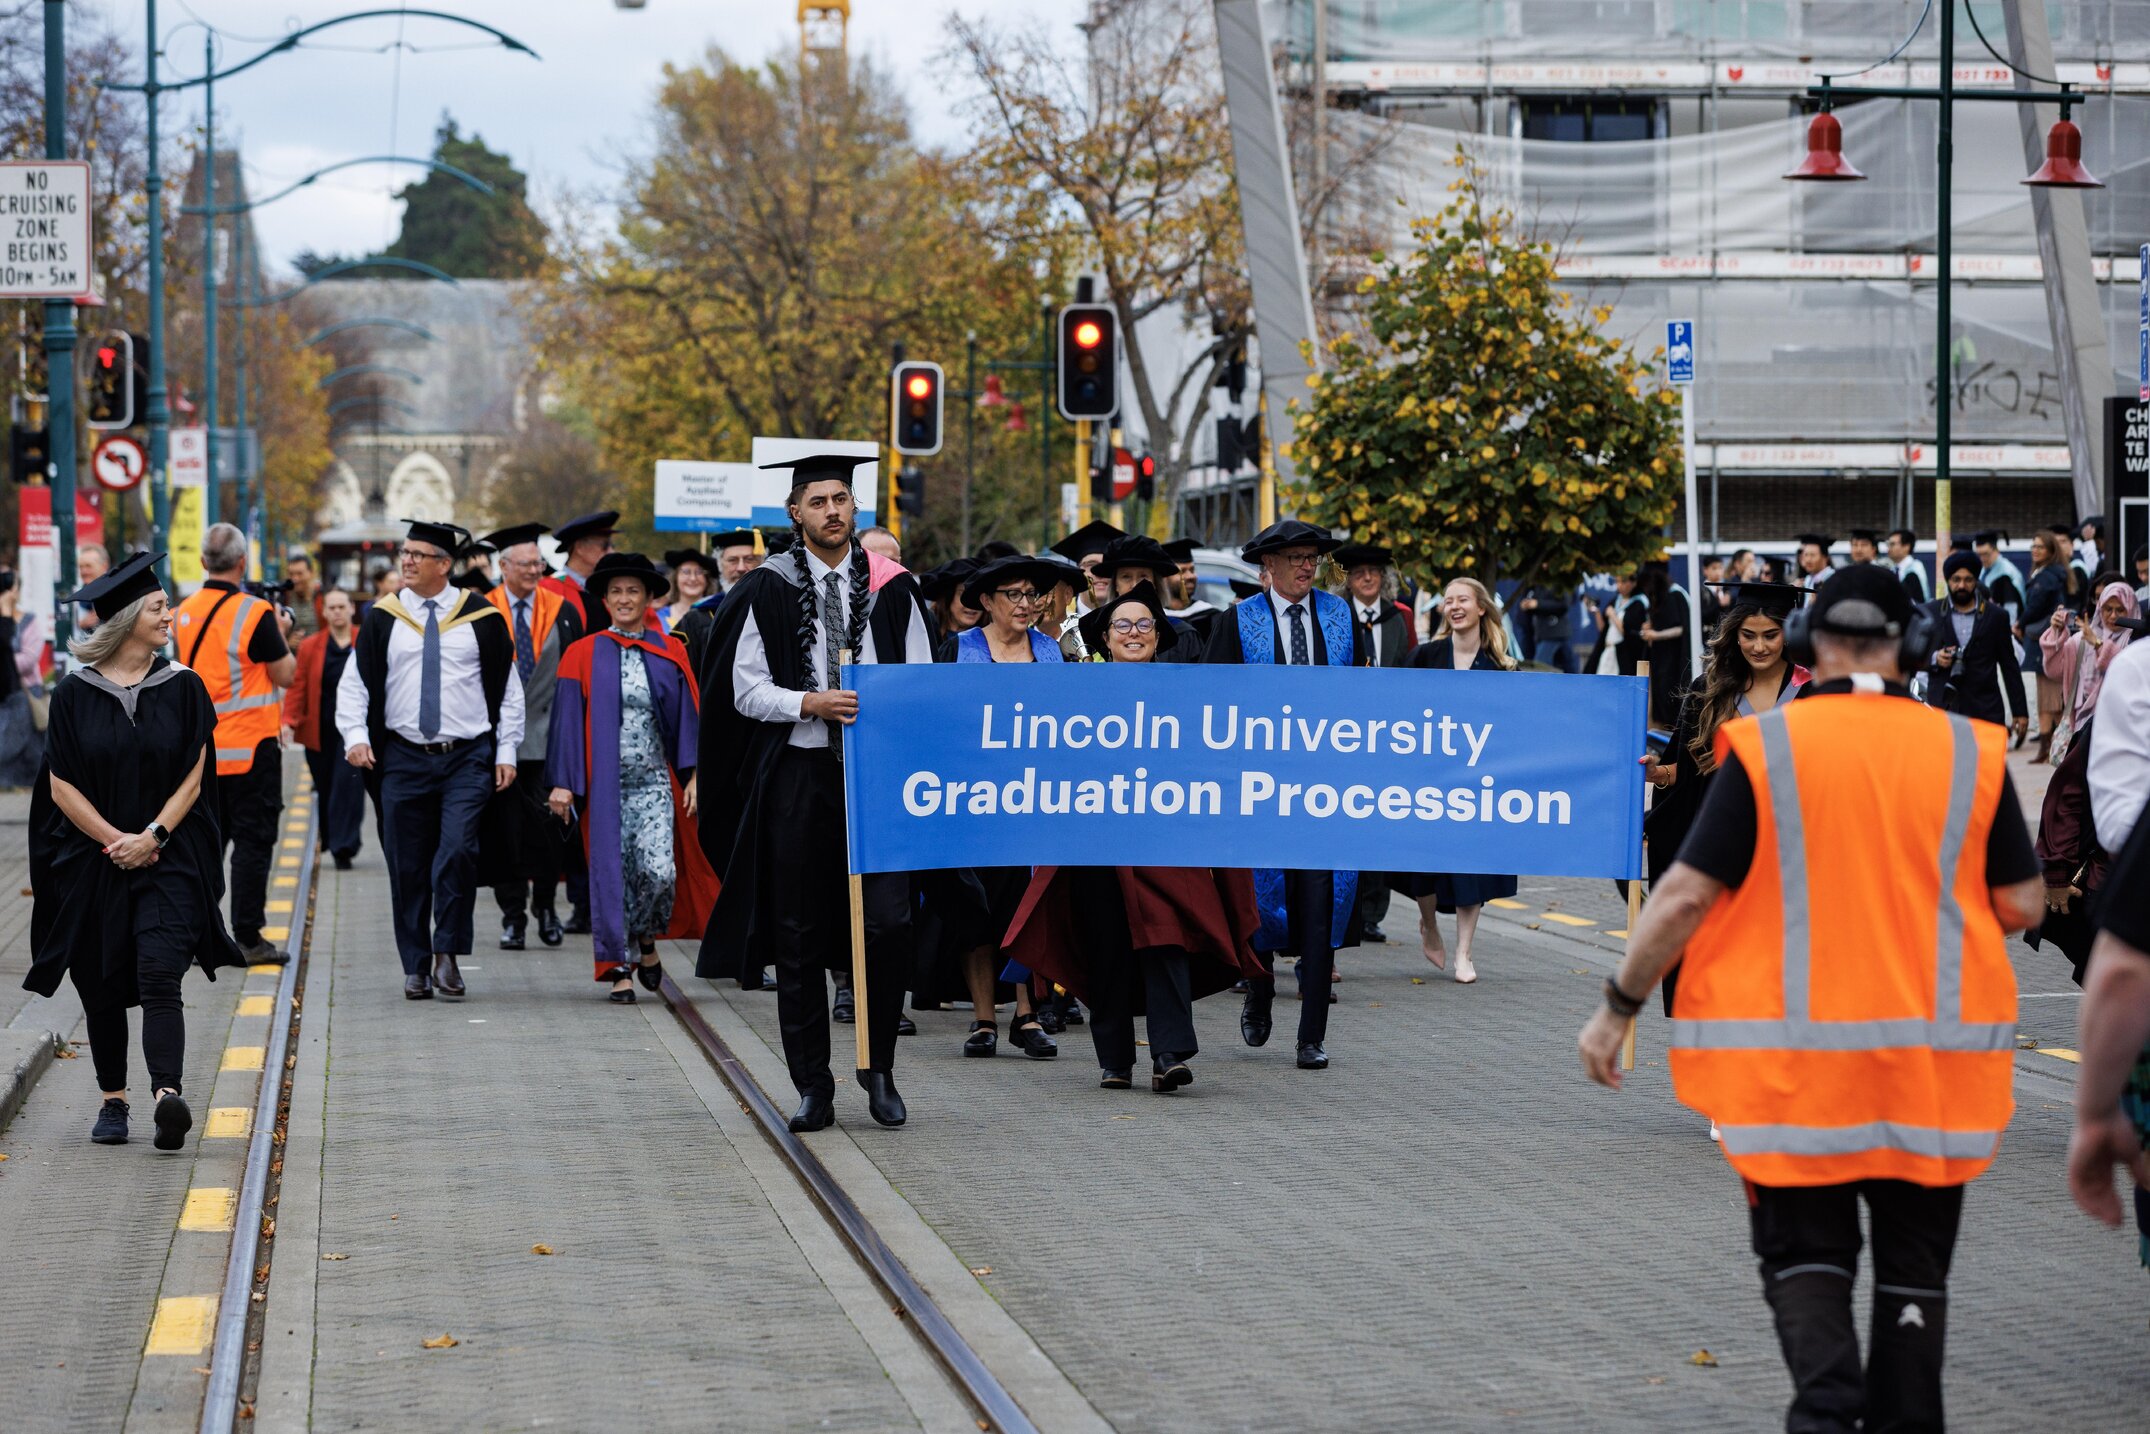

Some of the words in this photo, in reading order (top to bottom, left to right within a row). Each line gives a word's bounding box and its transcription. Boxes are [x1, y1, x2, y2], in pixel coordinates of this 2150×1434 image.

[26, 171, 48, 190] NO
[0, 194, 77, 215] CRUISING
[16, 219, 59, 238] ZONE
[8, 243, 68, 262] BEGINS
[1675, 323, 1685, 342] P
[2125, 441, 2145, 456] TE
[982, 702, 1179, 750] Lincoln
[1203, 705, 1493, 766] University
[903, 768, 1221, 816] Graduation
[1241, 772, 1570, 824] Procession
